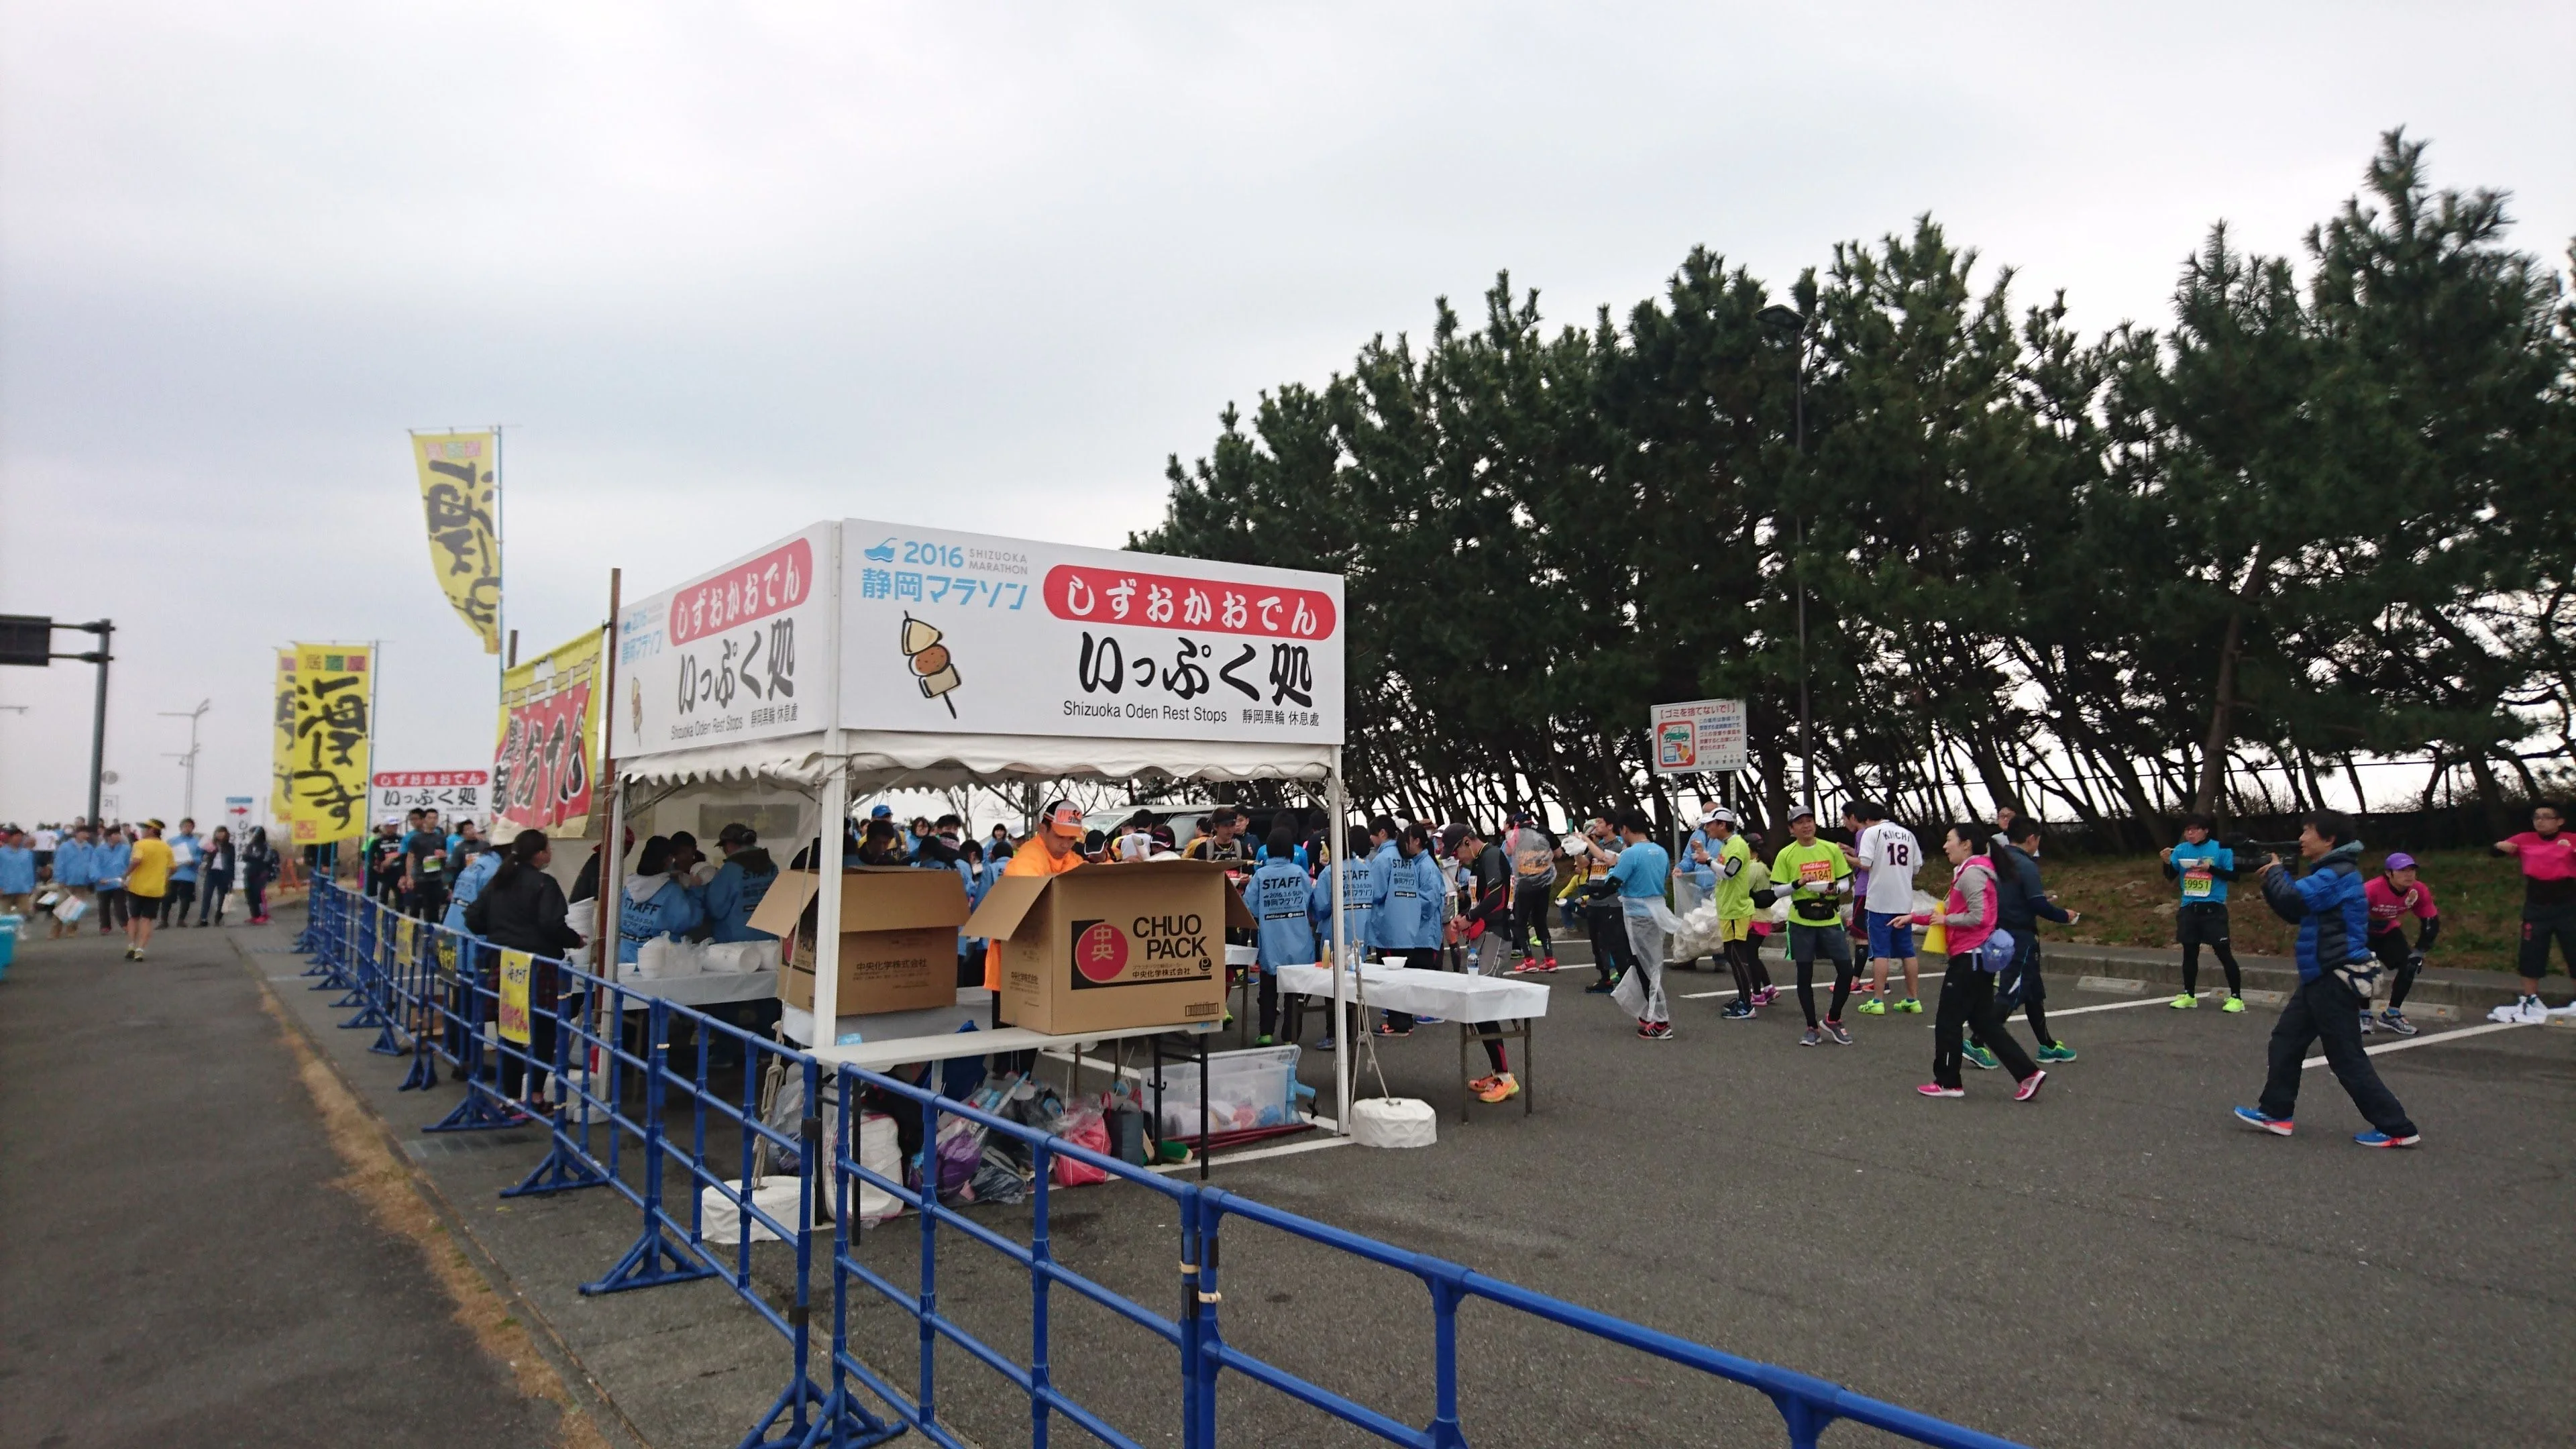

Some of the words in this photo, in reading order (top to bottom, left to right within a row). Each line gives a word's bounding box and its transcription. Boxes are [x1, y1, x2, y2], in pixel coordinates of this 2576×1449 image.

[904, 541, 964, 568] 2016
[969, 548, 1028, 564] SHIZUOKA
[969, 561, 1028, 575] MARATHON
[676, 553, 801, 639] しずおかおでん
[861, 568, 1028, 610] 静岡マラソン
[1067, 574, 1318, 636] しずおかおでん
[678, 616, 795, 715] いっぷく処
[1079, 631, 1313, 708] いっぷく処
[1063, 700, 1121, 718] Shizuoka
[1126, 704, 1159, 720] Oden
[1163, 705, 1189, 720] Rest
[1193, 707, 1227, 723] Stops
[380, 773, 480, 786] しずおかおでん
[384, 788, 477, 806] いっぷく処
[1887, 843, 1909, 866] 18
[1262, 877, 1301, 890] STAFF
[1132, 914, 1201, 938] CHUO
[1091, 926, 1114, 961] 中央
[1146, 936, 1208, 960] PACK
[856, 958, 927, 972] 中央化学株式会社
[1132, 967, 1191, 978] 中央化学株式会社
